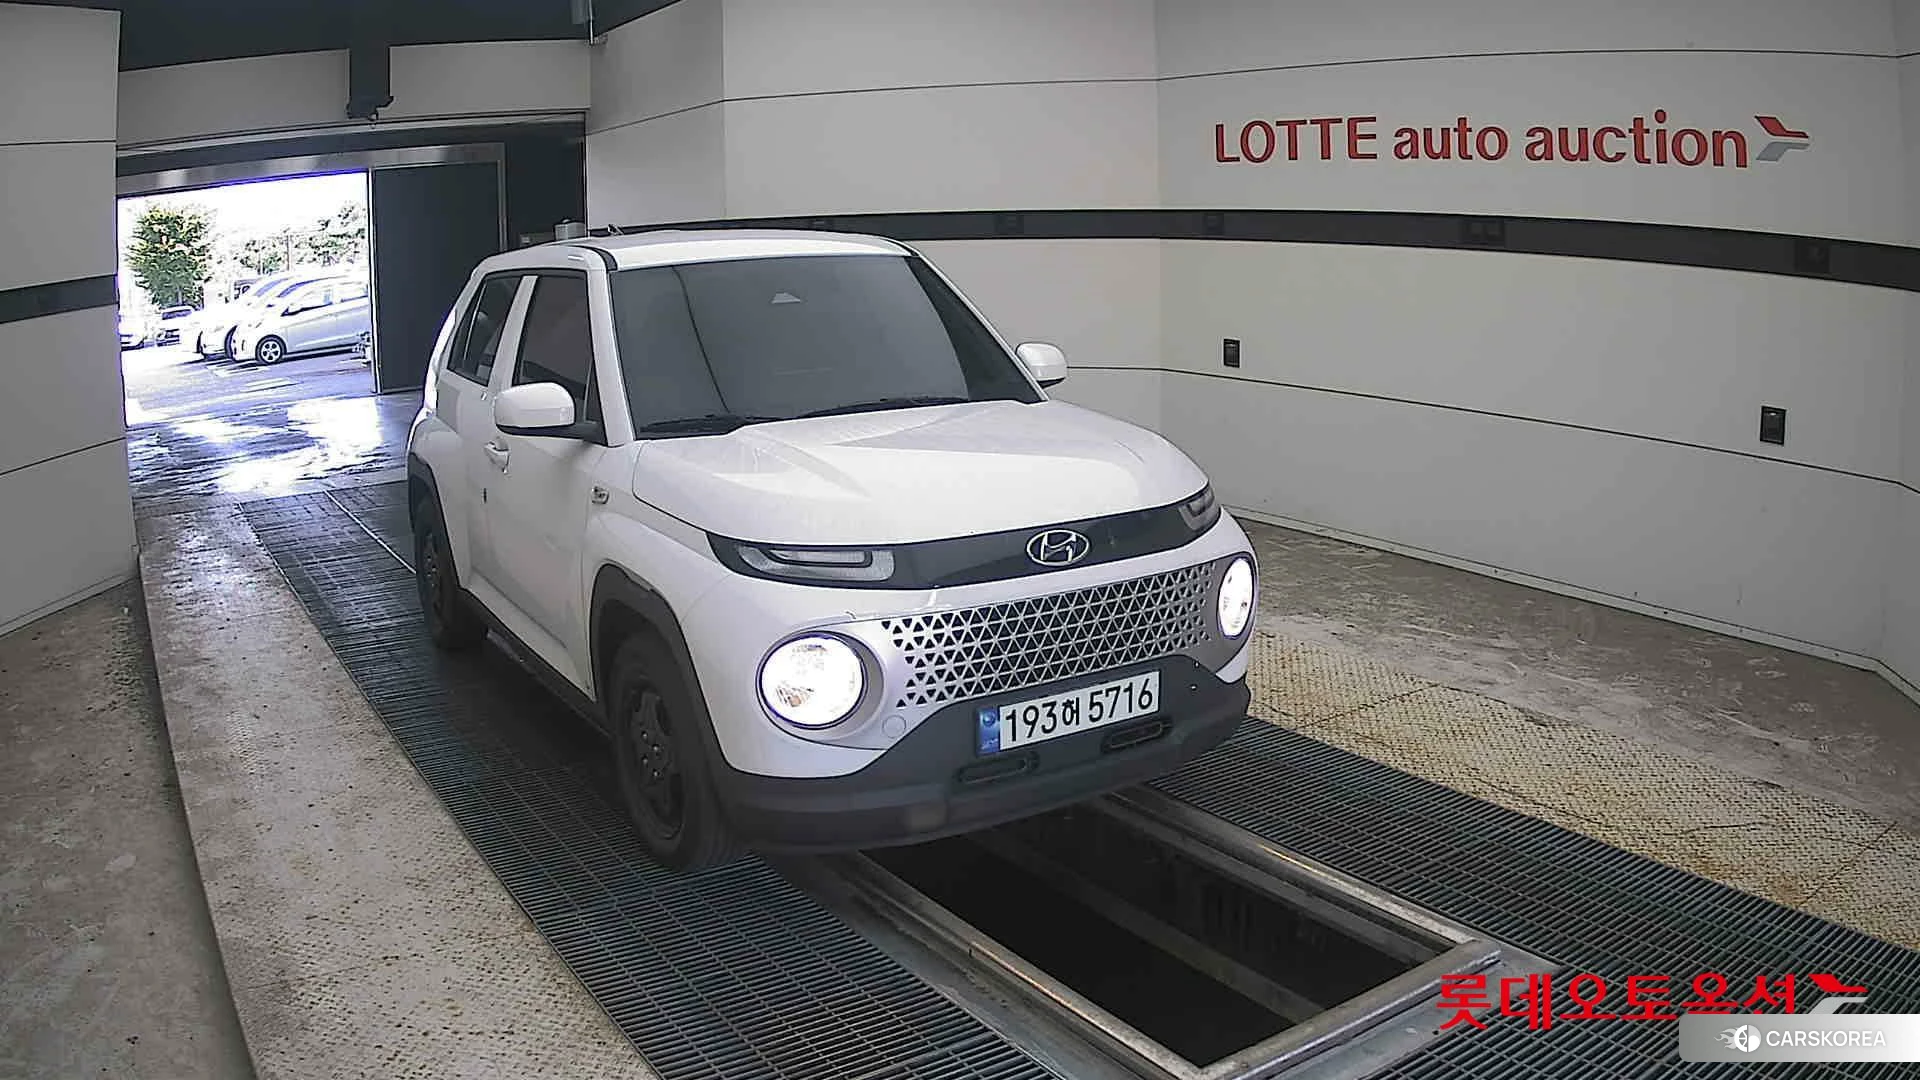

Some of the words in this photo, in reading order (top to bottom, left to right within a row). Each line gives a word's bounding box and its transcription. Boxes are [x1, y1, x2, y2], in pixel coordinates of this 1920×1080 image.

[1215, 116, 1377, 163] LOTTE
[1393, 116, 1508, 162] auto
[1523, 109, 1748, 168] auction
[1005, 696, 1080, 742] 193허
[1088, 678, 1153, 723] 5716
